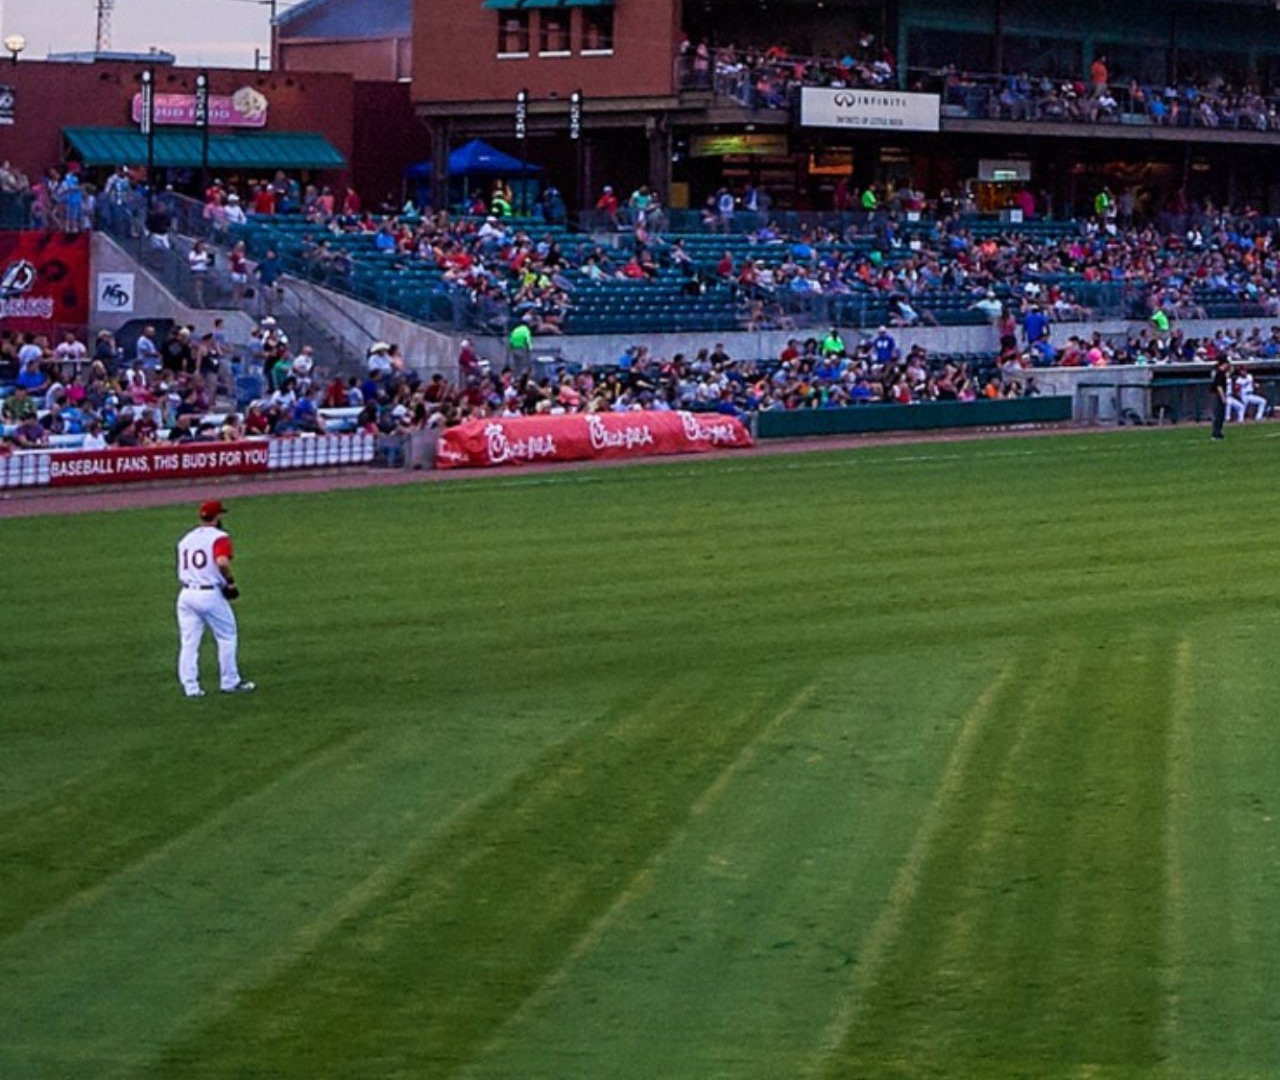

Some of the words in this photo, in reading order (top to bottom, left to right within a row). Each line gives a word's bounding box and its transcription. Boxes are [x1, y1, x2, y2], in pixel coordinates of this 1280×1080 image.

[858, 96, 907, 107] INFINITI
[51, 456, 113, 477] BASEBALL
[153, 454, 178, 470] THIS
[182, 452, 217, 469] BUD'S
[218, 450, 242, 466] FOR
[243, 448, 268, 465] YOU
[183, 548, 208, 570] 10
